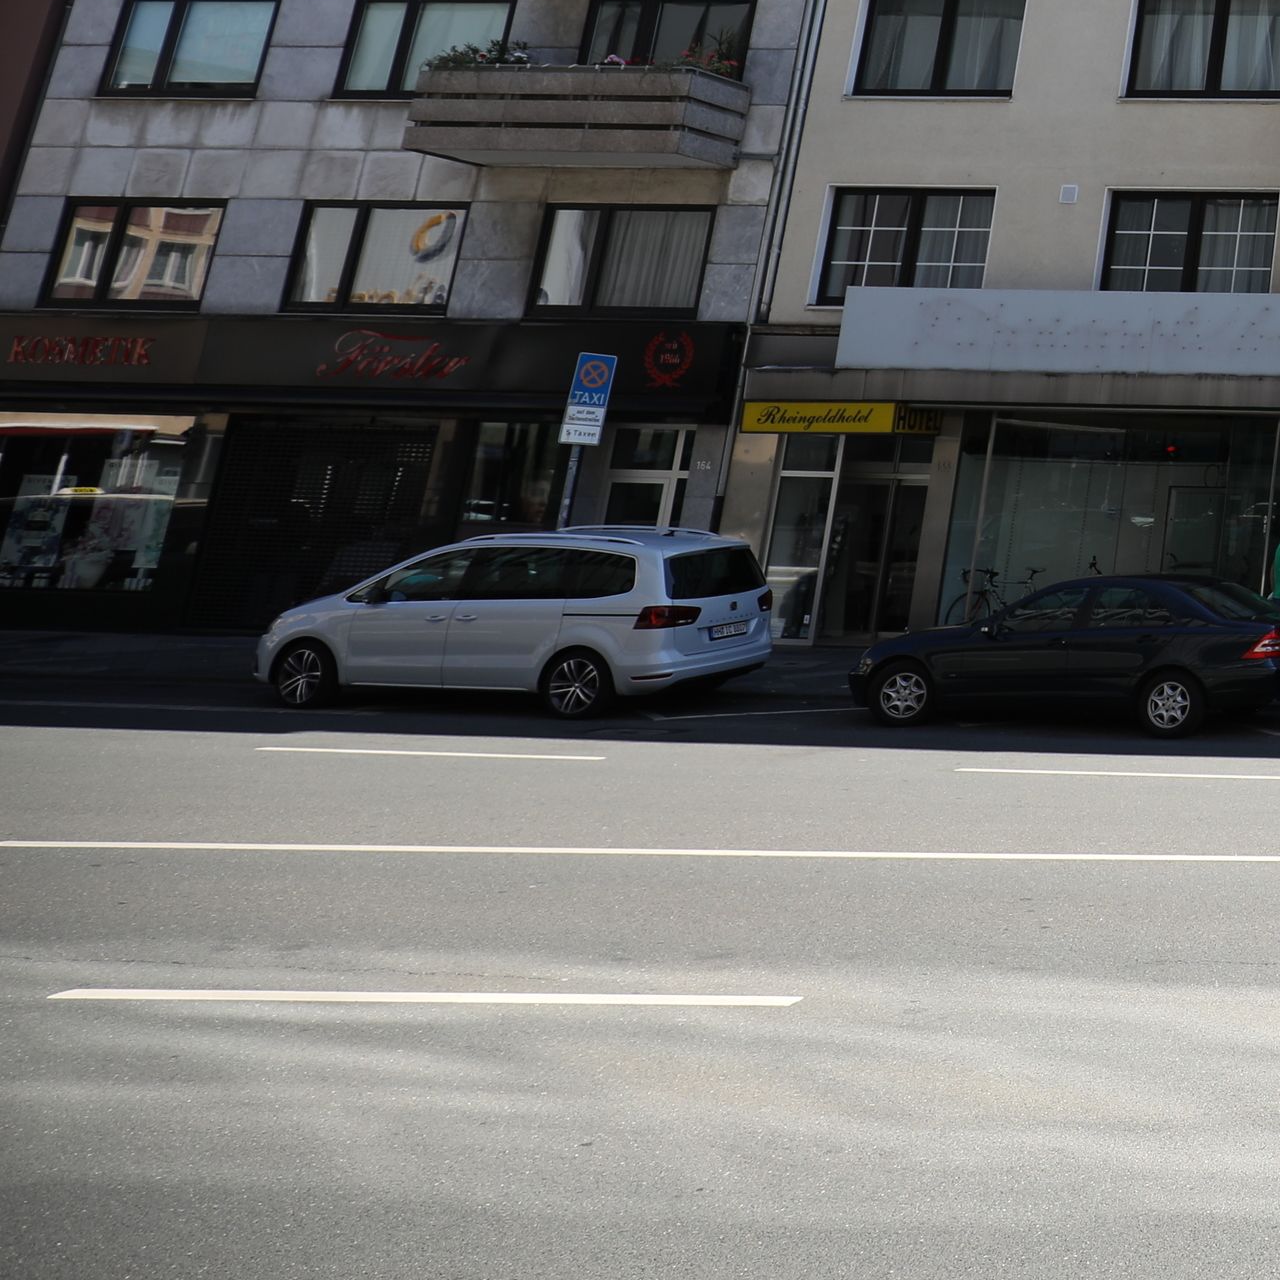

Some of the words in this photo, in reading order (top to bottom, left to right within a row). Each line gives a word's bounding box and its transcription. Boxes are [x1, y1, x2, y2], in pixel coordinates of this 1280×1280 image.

[7, 335, 155, 366] KOSMETIK
[316, 328, 471, 380] Förster
[573, 391, 606, 406] TAXI
[757, 405, 874, 430] Rheingoldhotel
[696, 460, 711, 470] 164
